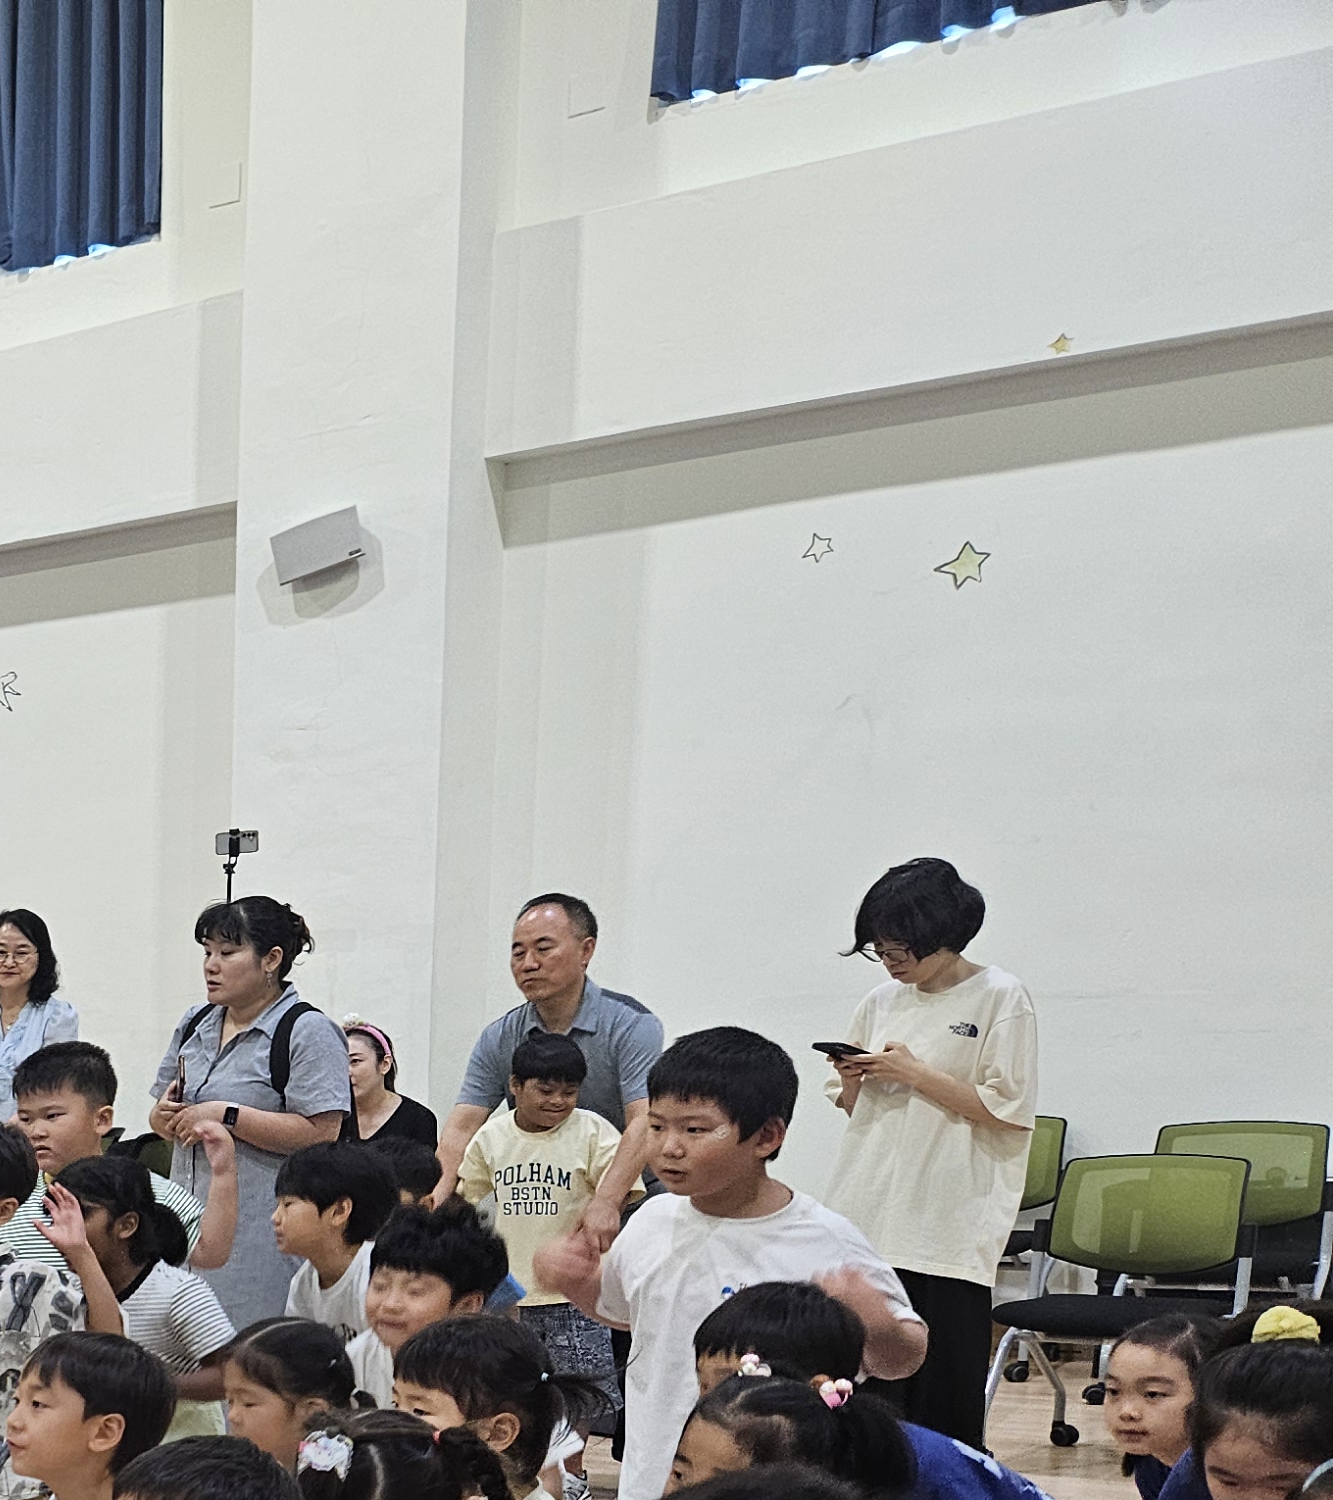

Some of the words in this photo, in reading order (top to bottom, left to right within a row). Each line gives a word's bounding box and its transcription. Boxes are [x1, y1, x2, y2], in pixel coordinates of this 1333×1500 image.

[494, 1162, 572, 1203] POLHAM
[511, 1186, 552, 1201] BSTN
[503, 1201, 559, 1216] STUDIO
